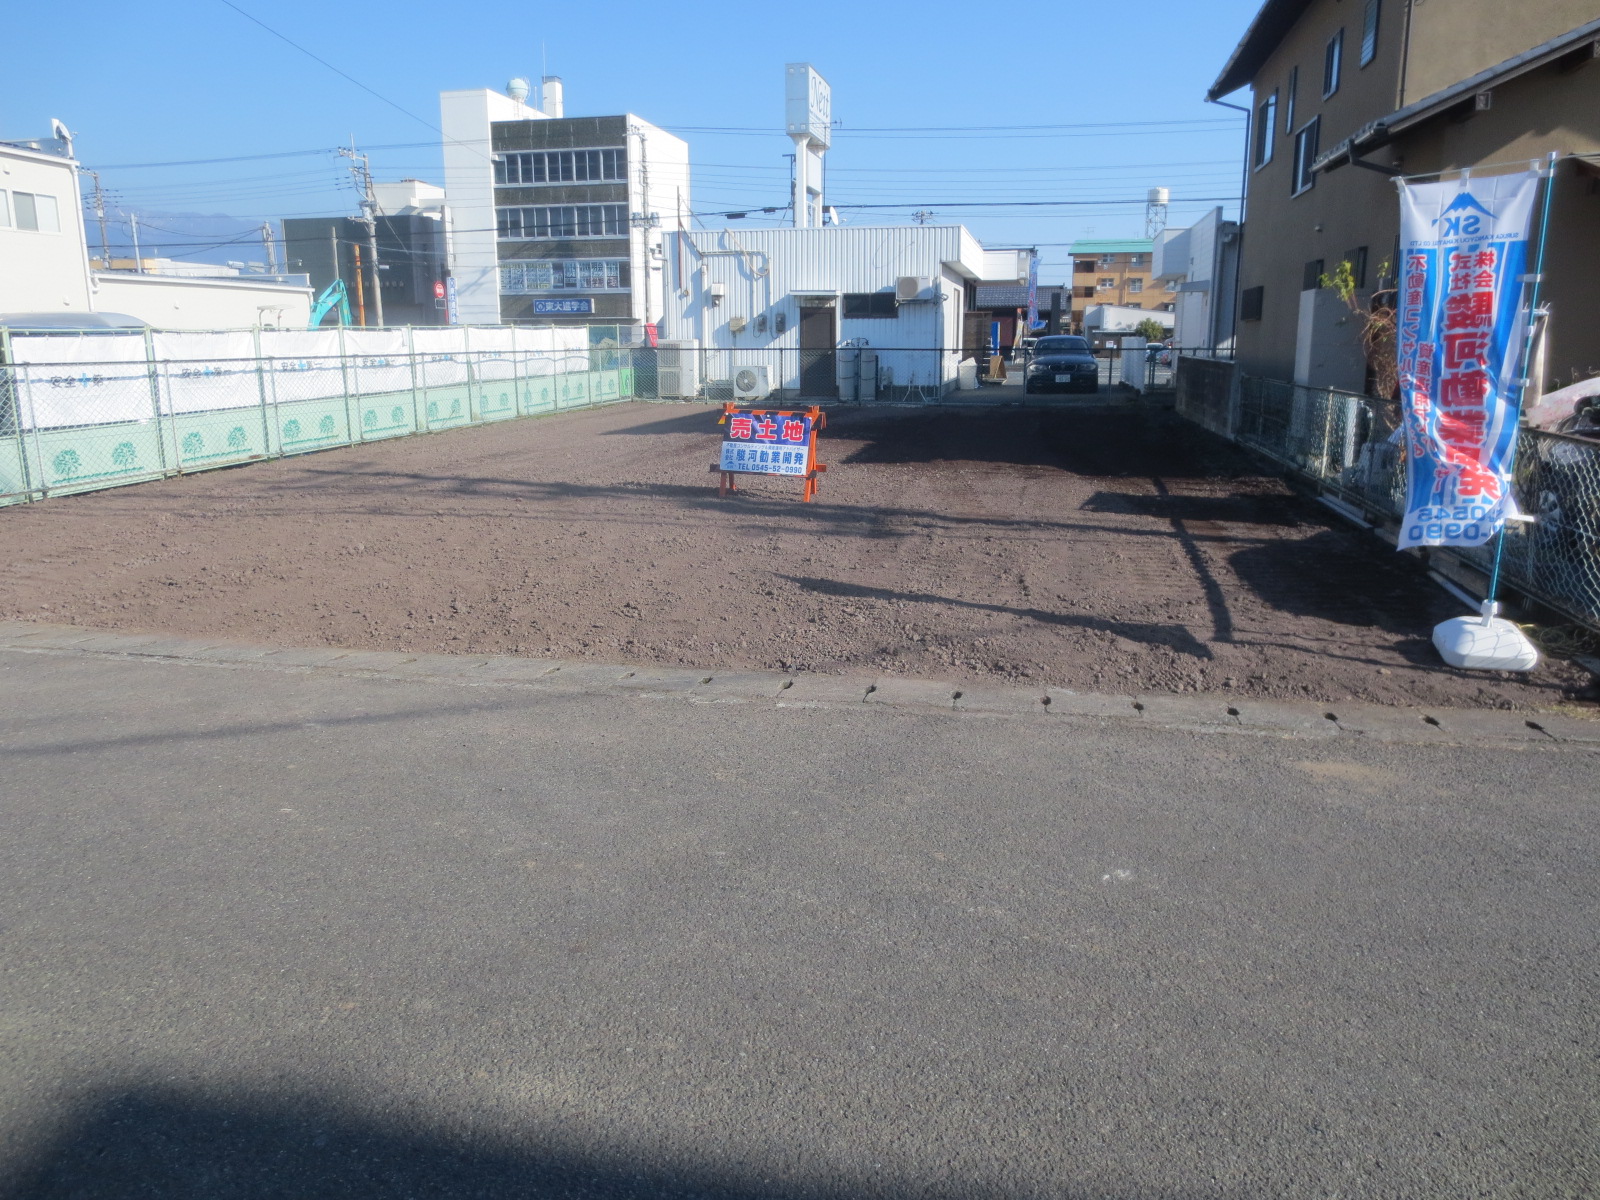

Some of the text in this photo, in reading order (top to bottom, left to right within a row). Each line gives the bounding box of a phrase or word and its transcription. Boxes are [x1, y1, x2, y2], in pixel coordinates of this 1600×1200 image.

[730, 418, 804, 441] 売土地
[752, 463, 802, 474] 0545-52-0990
